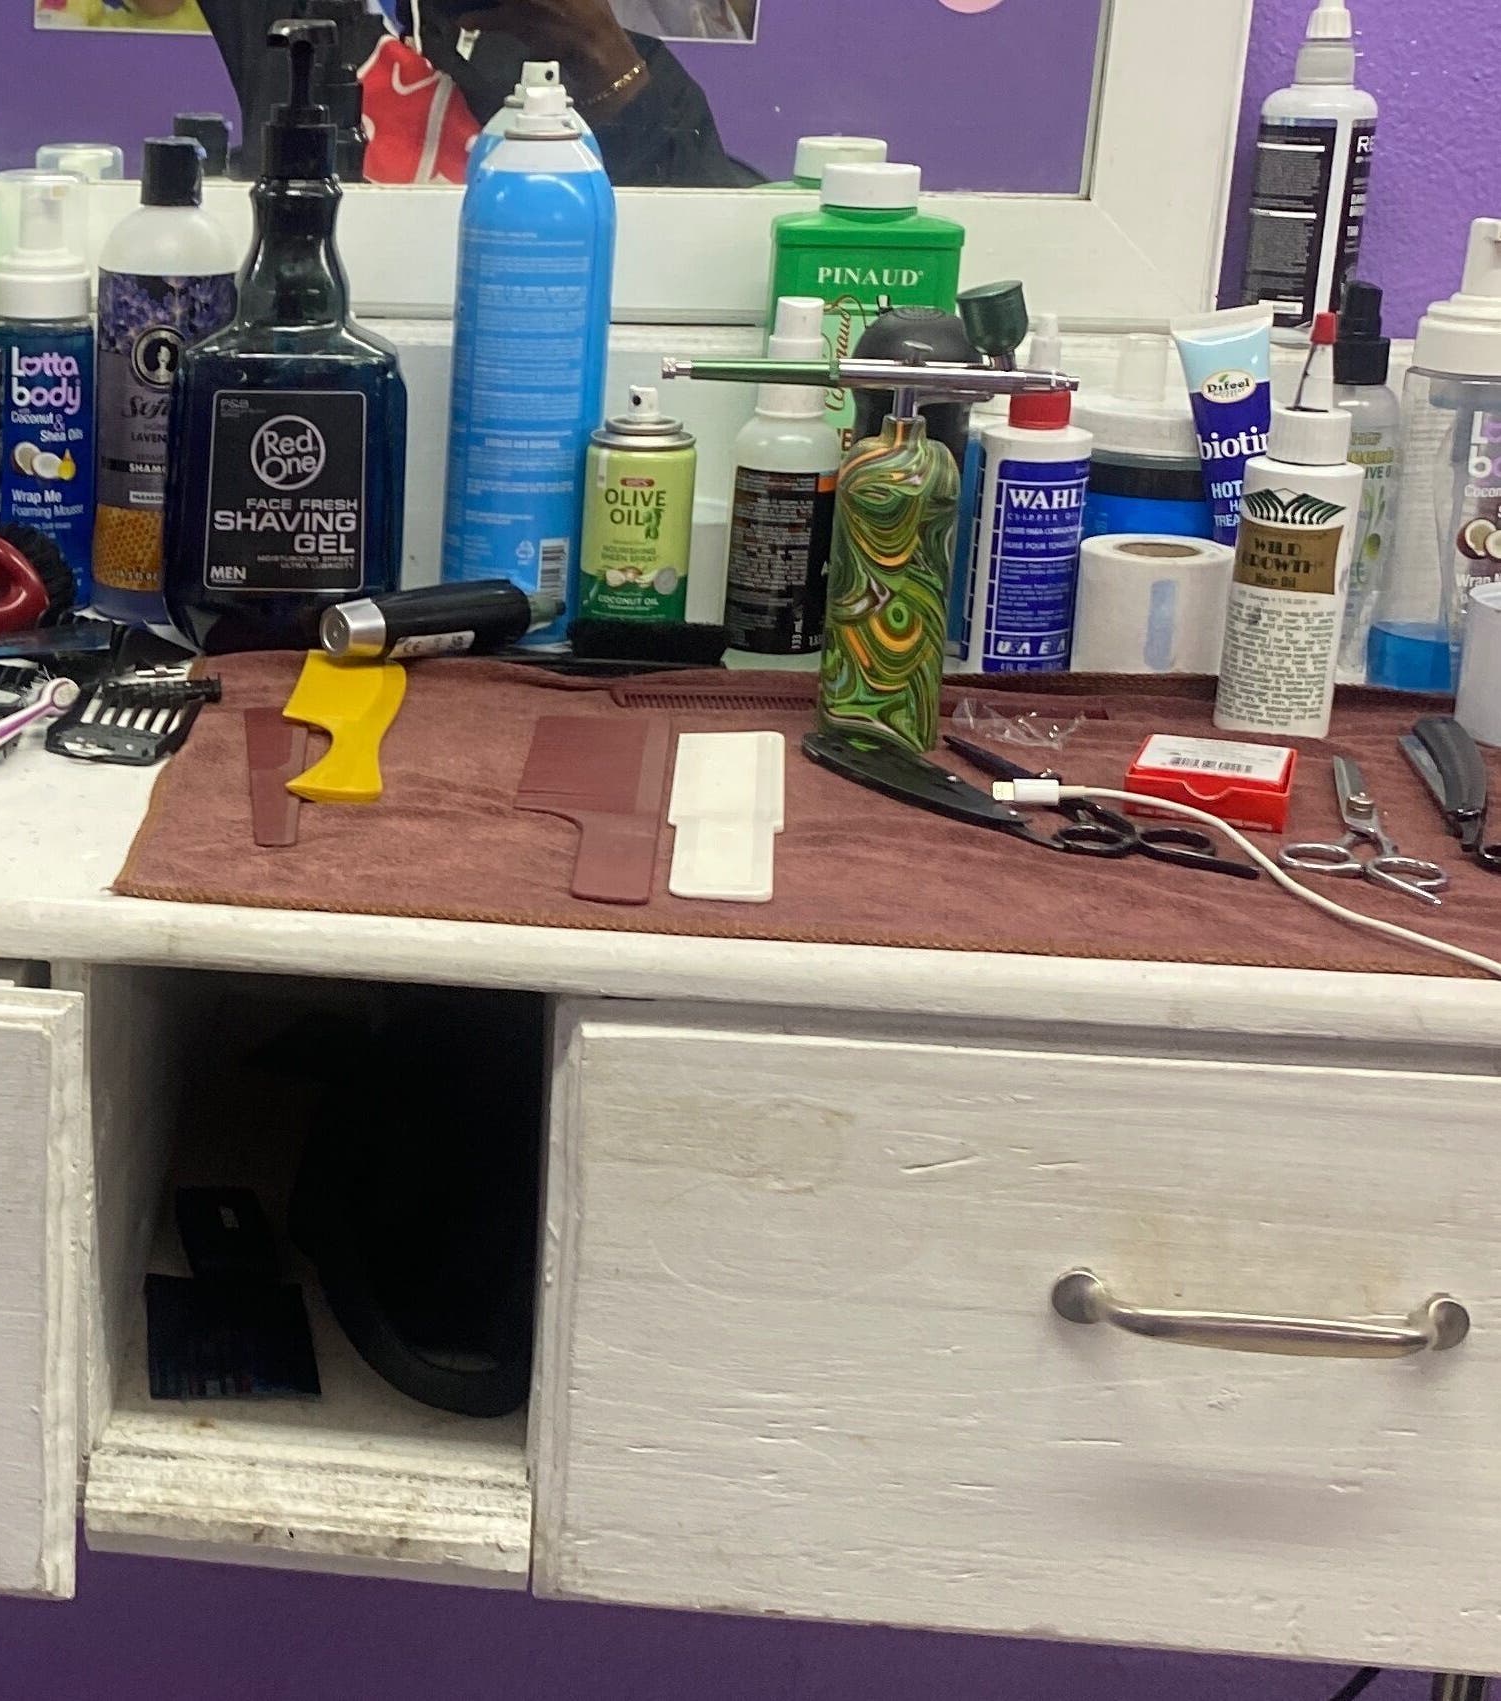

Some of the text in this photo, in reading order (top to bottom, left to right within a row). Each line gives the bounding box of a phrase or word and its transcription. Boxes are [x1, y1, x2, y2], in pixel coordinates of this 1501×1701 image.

[818, 266, 919, 286] PINAUD
[11, 346, 80, 377] Lotta
[10, 376, 82, 415] body
[1207, 378, 1250, 394] Difeel
[130, 431, 168, 444] LAVEN
[261, 428, 313, 457] Red
[128, 462, 166, 474] SHAM
[261, 454, 317, 483] One
[11, 489, 62, 506] Wrap Me
[246, 498, 358, 511] FACE FRESH
[605, 488, 667, 507] OLIVE
[1008, 487, 1080, 510] WAHL
[213, 510, 357, 532] SHAVING
[610, 508, 645, 526] OIL
[294, 533, 356, 554] GEL
[210, 566, 247, 580] MEN
